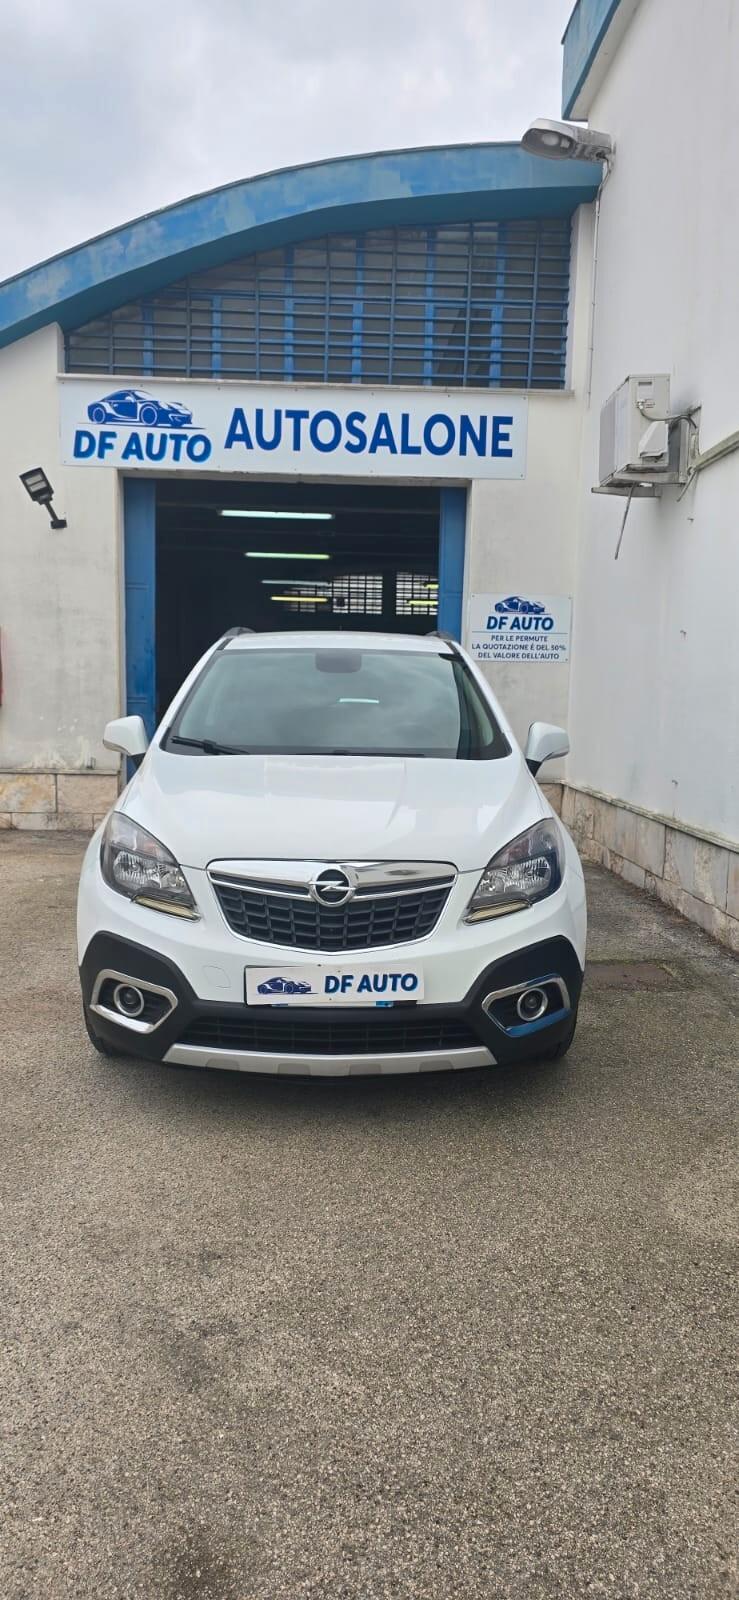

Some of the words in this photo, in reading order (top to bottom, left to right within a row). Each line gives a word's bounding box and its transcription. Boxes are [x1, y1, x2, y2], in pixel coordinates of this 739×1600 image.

[224, 407, 514, 458] AUTOSALONE
[73, 430, 116, 461] DF
[122, 432, 212, 463] AUTO
[486, 616, 509, 630] DF
[510, 616, 554, 631] AUTO
[482, 643, 529, 651] QUOTAZIONE
[324, 975, 353, 994] DF
[357, 973, 418, 993] AUTO
